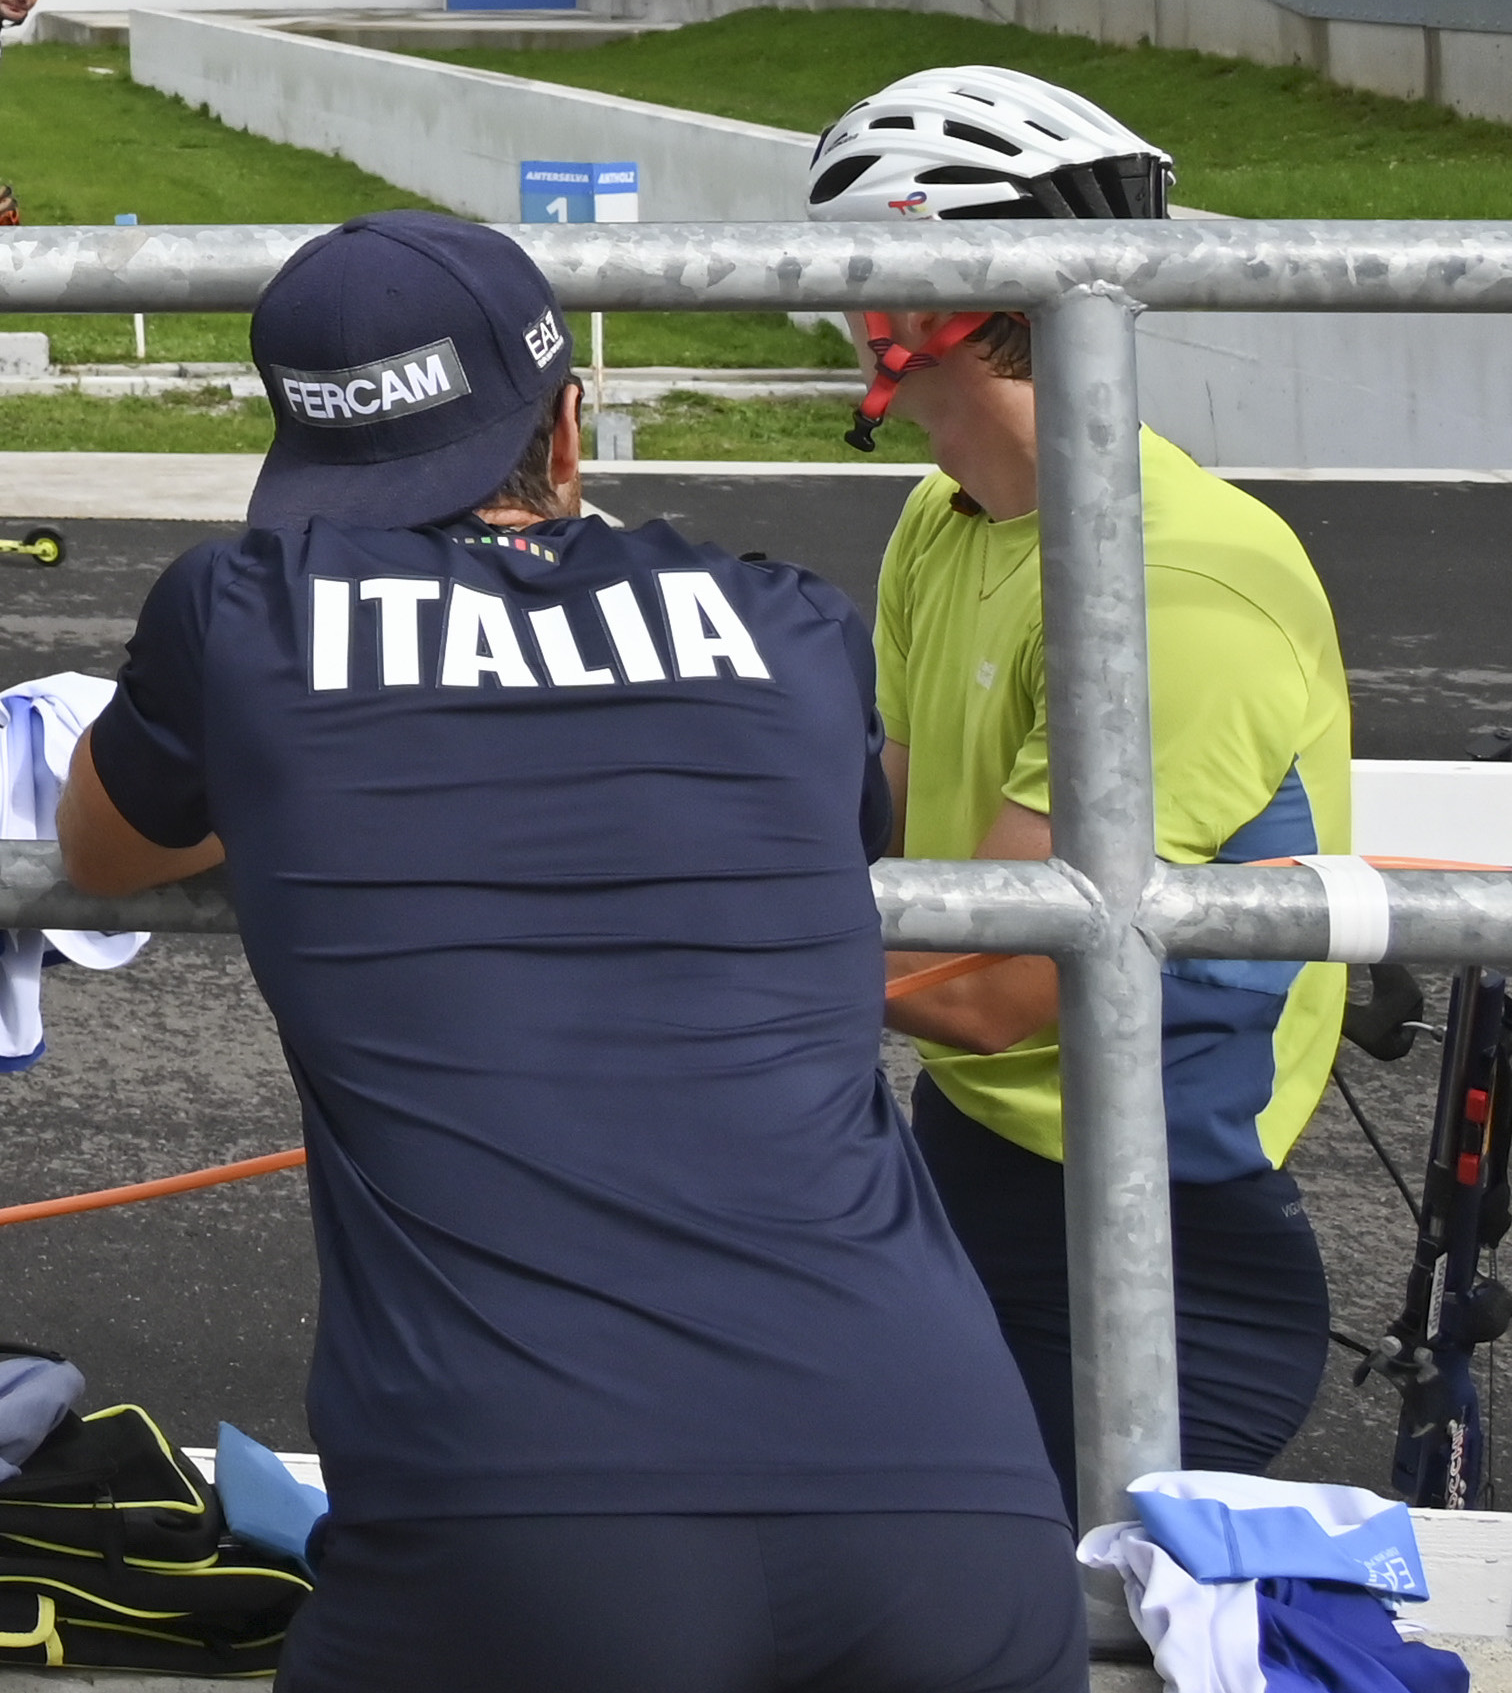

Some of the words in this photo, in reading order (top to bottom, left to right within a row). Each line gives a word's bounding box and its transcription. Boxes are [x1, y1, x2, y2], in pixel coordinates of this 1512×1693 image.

[526, 171, 590, 183] ANTERSELVA
[525, 310, 559, 361] EA7
[282, 353, 451, 419] FERCAM
[313, 570, 771, 692] ITALIA
